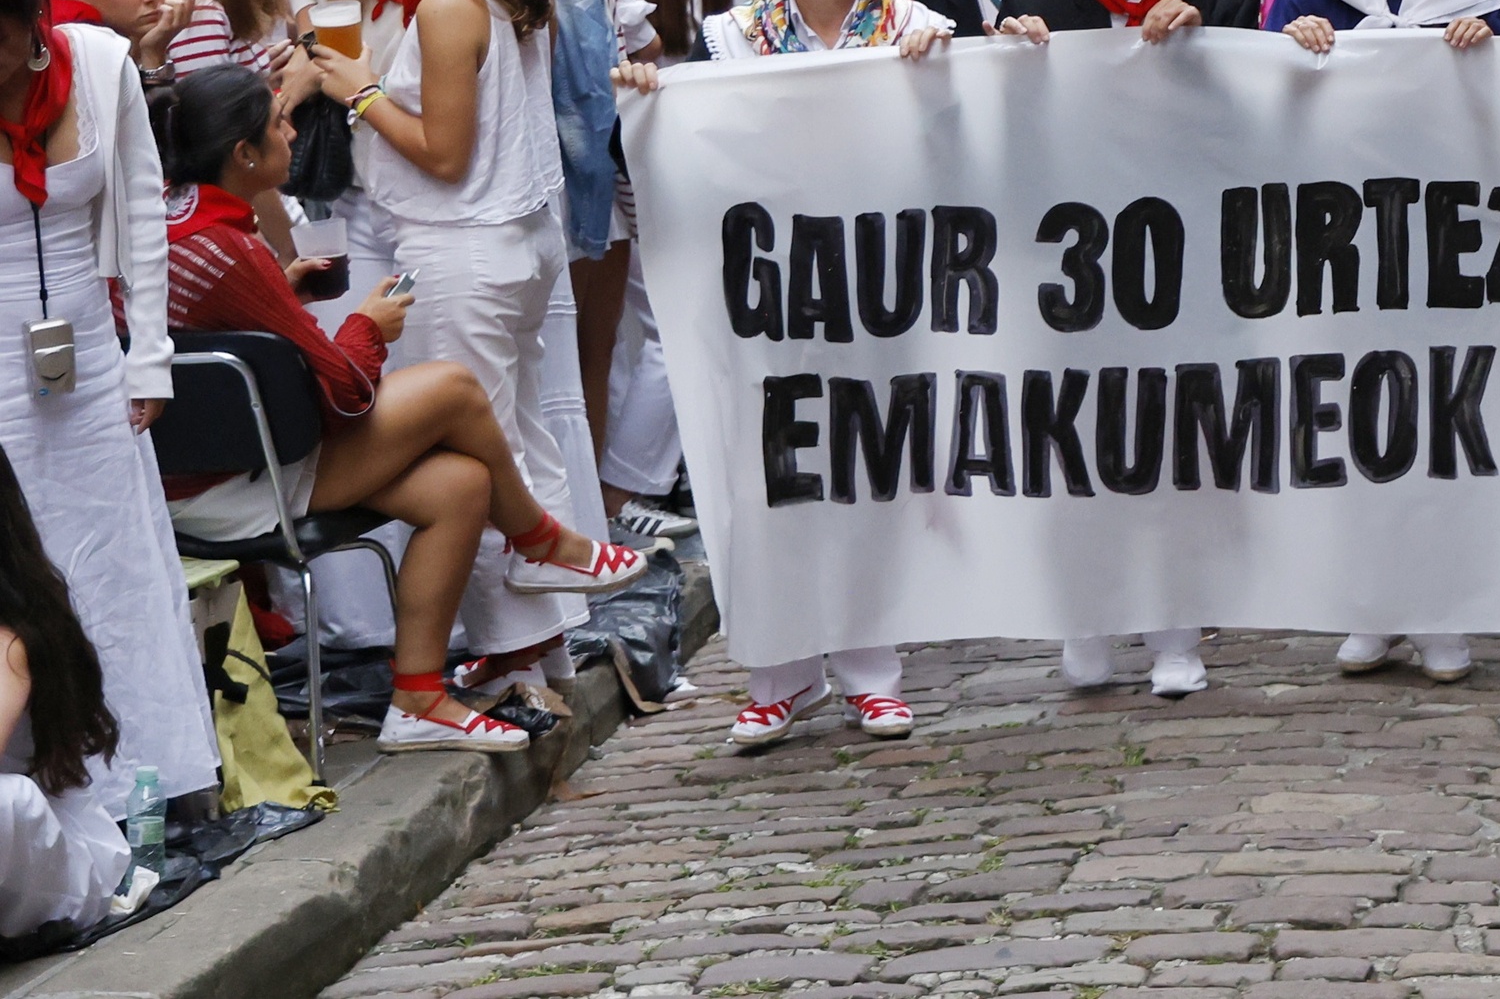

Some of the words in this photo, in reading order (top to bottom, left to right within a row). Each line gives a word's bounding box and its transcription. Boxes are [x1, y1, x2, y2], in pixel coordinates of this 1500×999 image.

[720, 200, 1000, 345] GAUR
[1034, 195, 1187, 334] 30
[760, 344, 1499, 510] EMAKUMEOK
